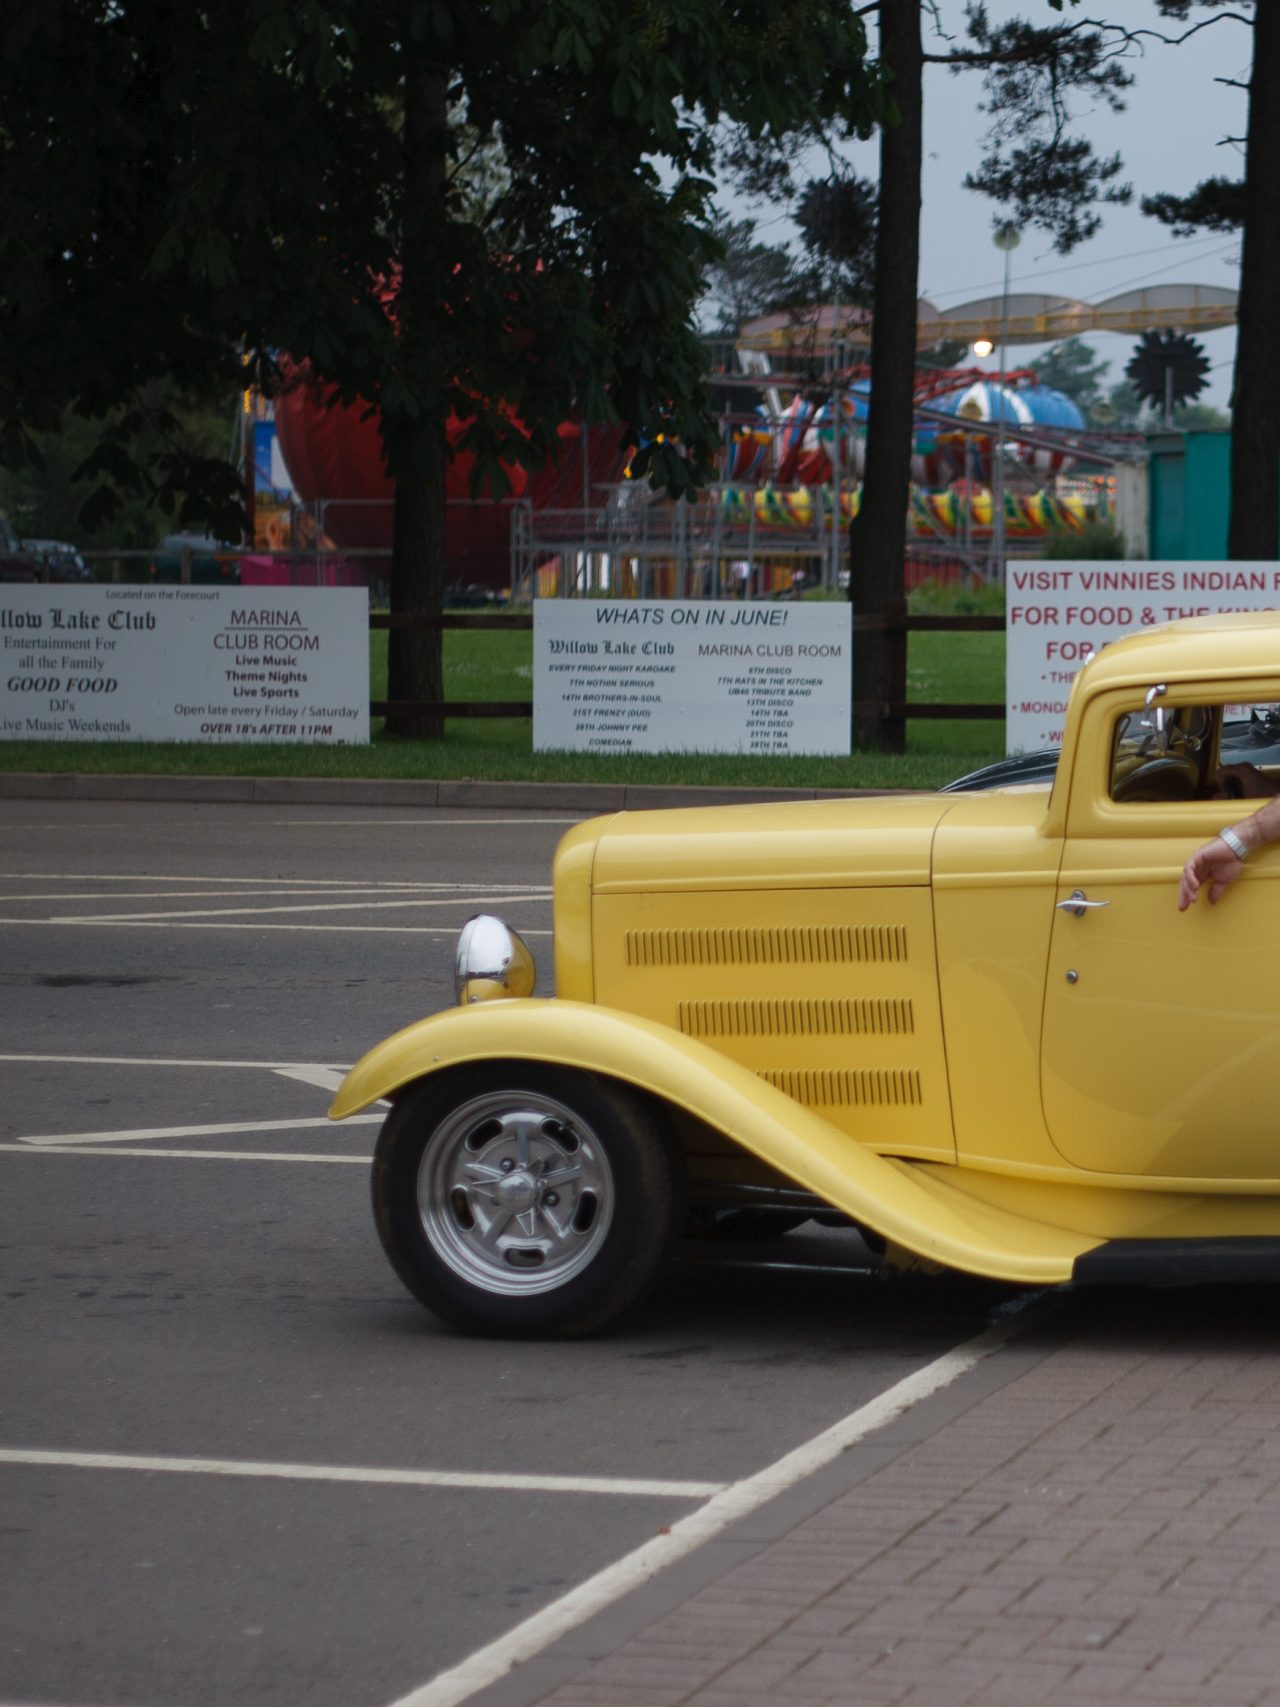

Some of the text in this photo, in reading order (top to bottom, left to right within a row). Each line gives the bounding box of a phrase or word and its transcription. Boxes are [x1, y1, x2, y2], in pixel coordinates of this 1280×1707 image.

[1013, 571, 1072, 591] VISIT
[1079, 571, 1176, 591] VINNIES
[1183, 572, 1266, 591] INDIAN
[106, 590, 220, 601] Located on the Forecourt
[50, 608, 100, 630] Lake
[107, 610, 156, 631] Club
[231, 610, 301, 625] MARINA
[596, 608, 789, 626] WHATS ON IN JUNE!
[1011, 607, 1058, 626] FOR
[1066, 607, 1133, 626] FOOD
[1140, 607, 1156, 626] &
[4, 636, 117, 650] Entertainment For
[213, 634, 320, 651] CLUB ROOM
[548, 639, 675, 656] Willow Lake Club
[698, 644, 842, 657] MARINA CLUB ROOM
[1046, 642, 1093, 661] FOR
[19, 656, 105, 672] all the Family
[235, 655, 298, 666] Live Music
[549, 664, 576, 672] EVERY
[577, 664, 607, 673] FRIDAY
[608, 665, 634, 673] NIGHT
[766, 667, 792, 675] DISCO
[225, 671, 308, 684] Theme Nights
[569, 679, 655, 688] 7TH NOTHIN SERIOUS
[718, 677, 733, 685] 7TH
[786, 678, 823, 686] KITCHEN
[7, 676, 118, 693] GOOD FOOD
[233, 687, 300, 700] Live Sports
[752, 688, 786, 696] TRIBUTE
[788, 689, 811, 697] BAND
[49, 699, 75, 712] DJ's
[768, 699, 794, 707] DISCO
[174, 704, 205, 717] Open
[208, 704, 228, 715] late
[231, 705, 262, 718] every
[265, 704, 299, 718] Friday
[309, 705, 359, 720] Saturday
[594, 709, 626, 717] FRENZY
[0, 718, 131, 733] ive Music Weekends
[200, 722, 333, 736] OVER 18's AFTER 11PM
[597, 724, 630, 732] JOHNNY
[767, 720, 794, 728] DISCO
[589, 738, 632, 746] COMEDIAN
